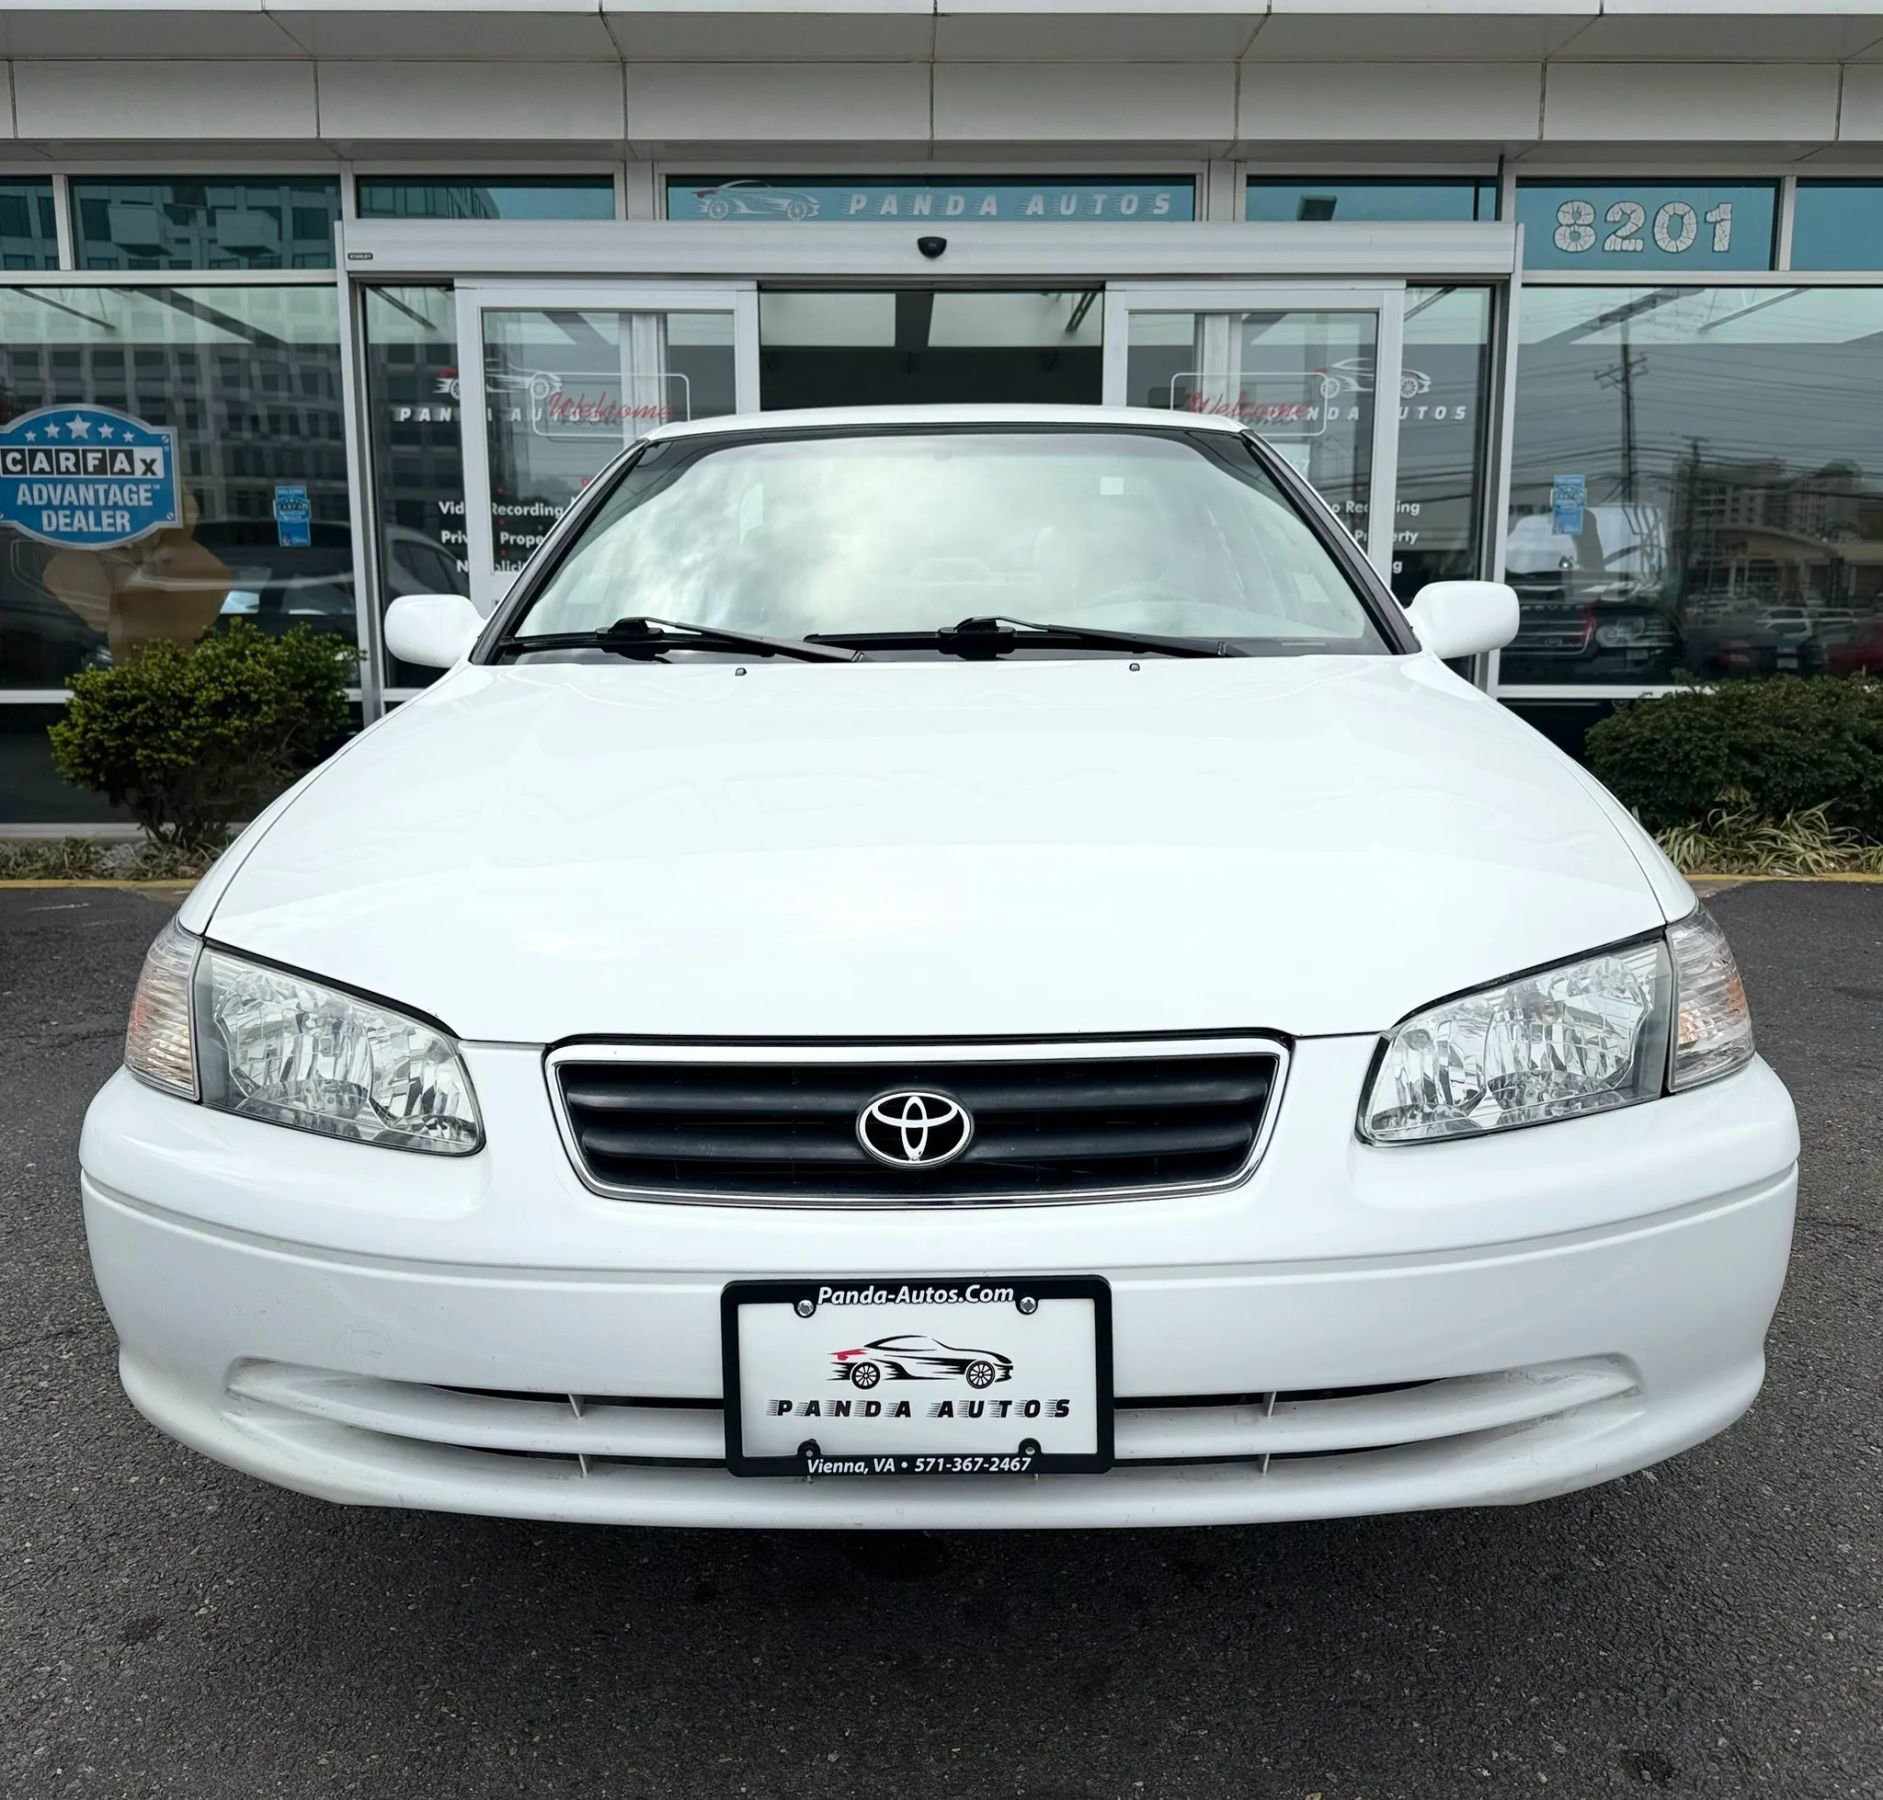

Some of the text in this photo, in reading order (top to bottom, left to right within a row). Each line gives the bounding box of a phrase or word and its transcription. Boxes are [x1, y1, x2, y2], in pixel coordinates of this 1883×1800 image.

[845, 193, 1171, 216] PANDA AUTOS
[1553, 200, 1733, 253] 8201
[548, 390, 673, 421] Welcome
[1398, 405, 1467, 421] UTOS
[5, 451, 158, 476] CARFAX
[438, 500, 466, 515] Vid
[41, 510, 131, 532] DEALER
[500, 531, 544, 548] Prope
[817, 1284, 1014, 1305] Panda-Autos.Com
[767, 1398, 1071, 1418] PANDA AUTOS
[806, 1457, 1032, 1475] Vienna, VA 571-367-2467
